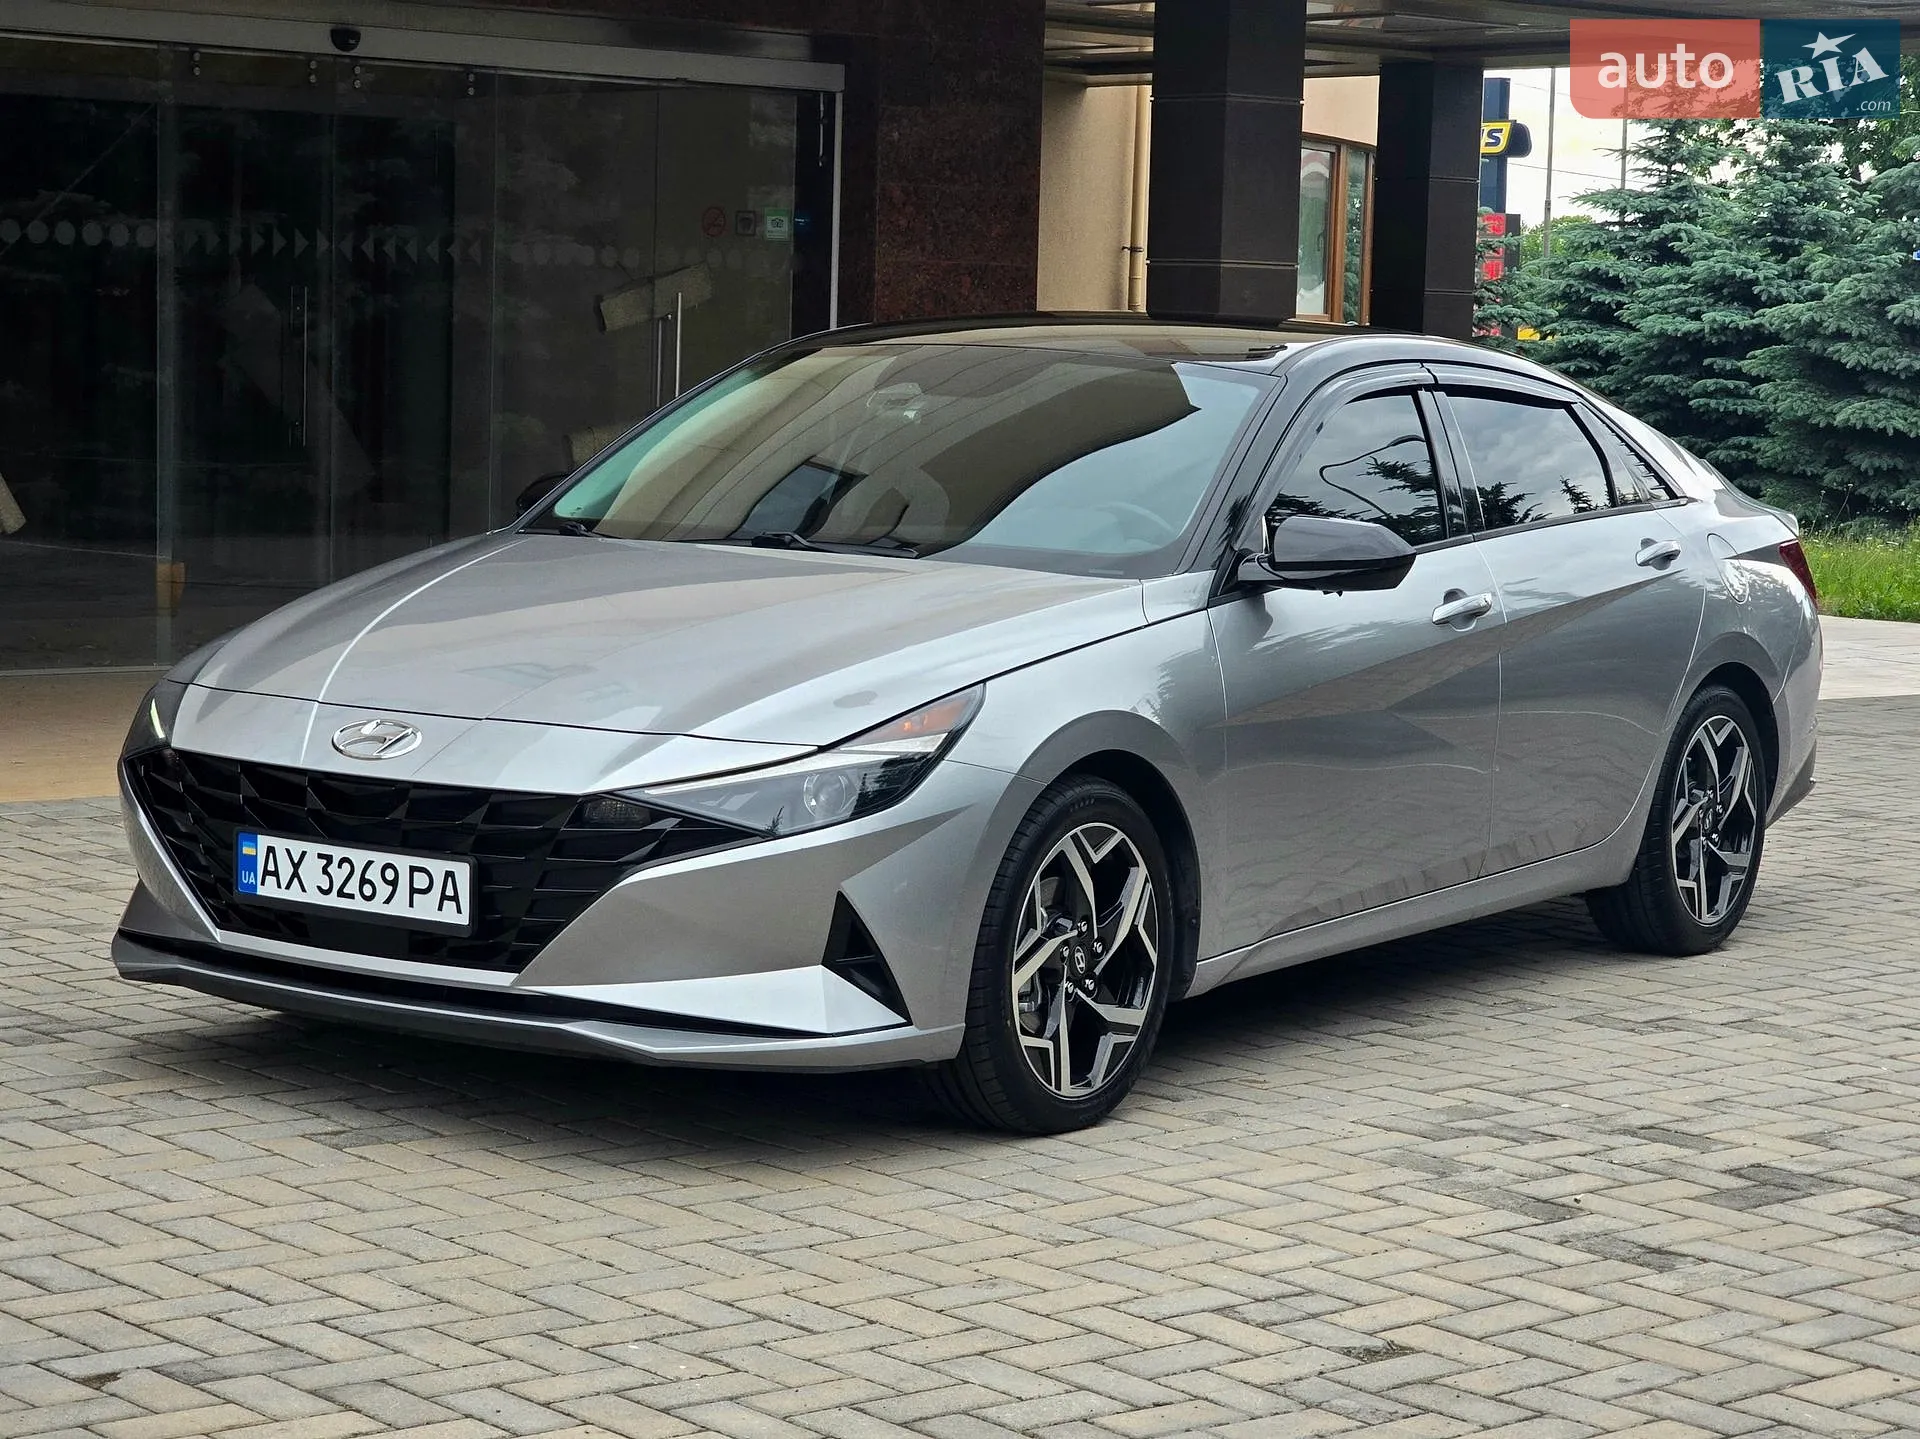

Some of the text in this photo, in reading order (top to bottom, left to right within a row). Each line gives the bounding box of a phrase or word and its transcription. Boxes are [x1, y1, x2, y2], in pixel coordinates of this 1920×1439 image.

[241, 870, 256, 886] UA
[260, 845, 463, 915] AX 3269 PA
